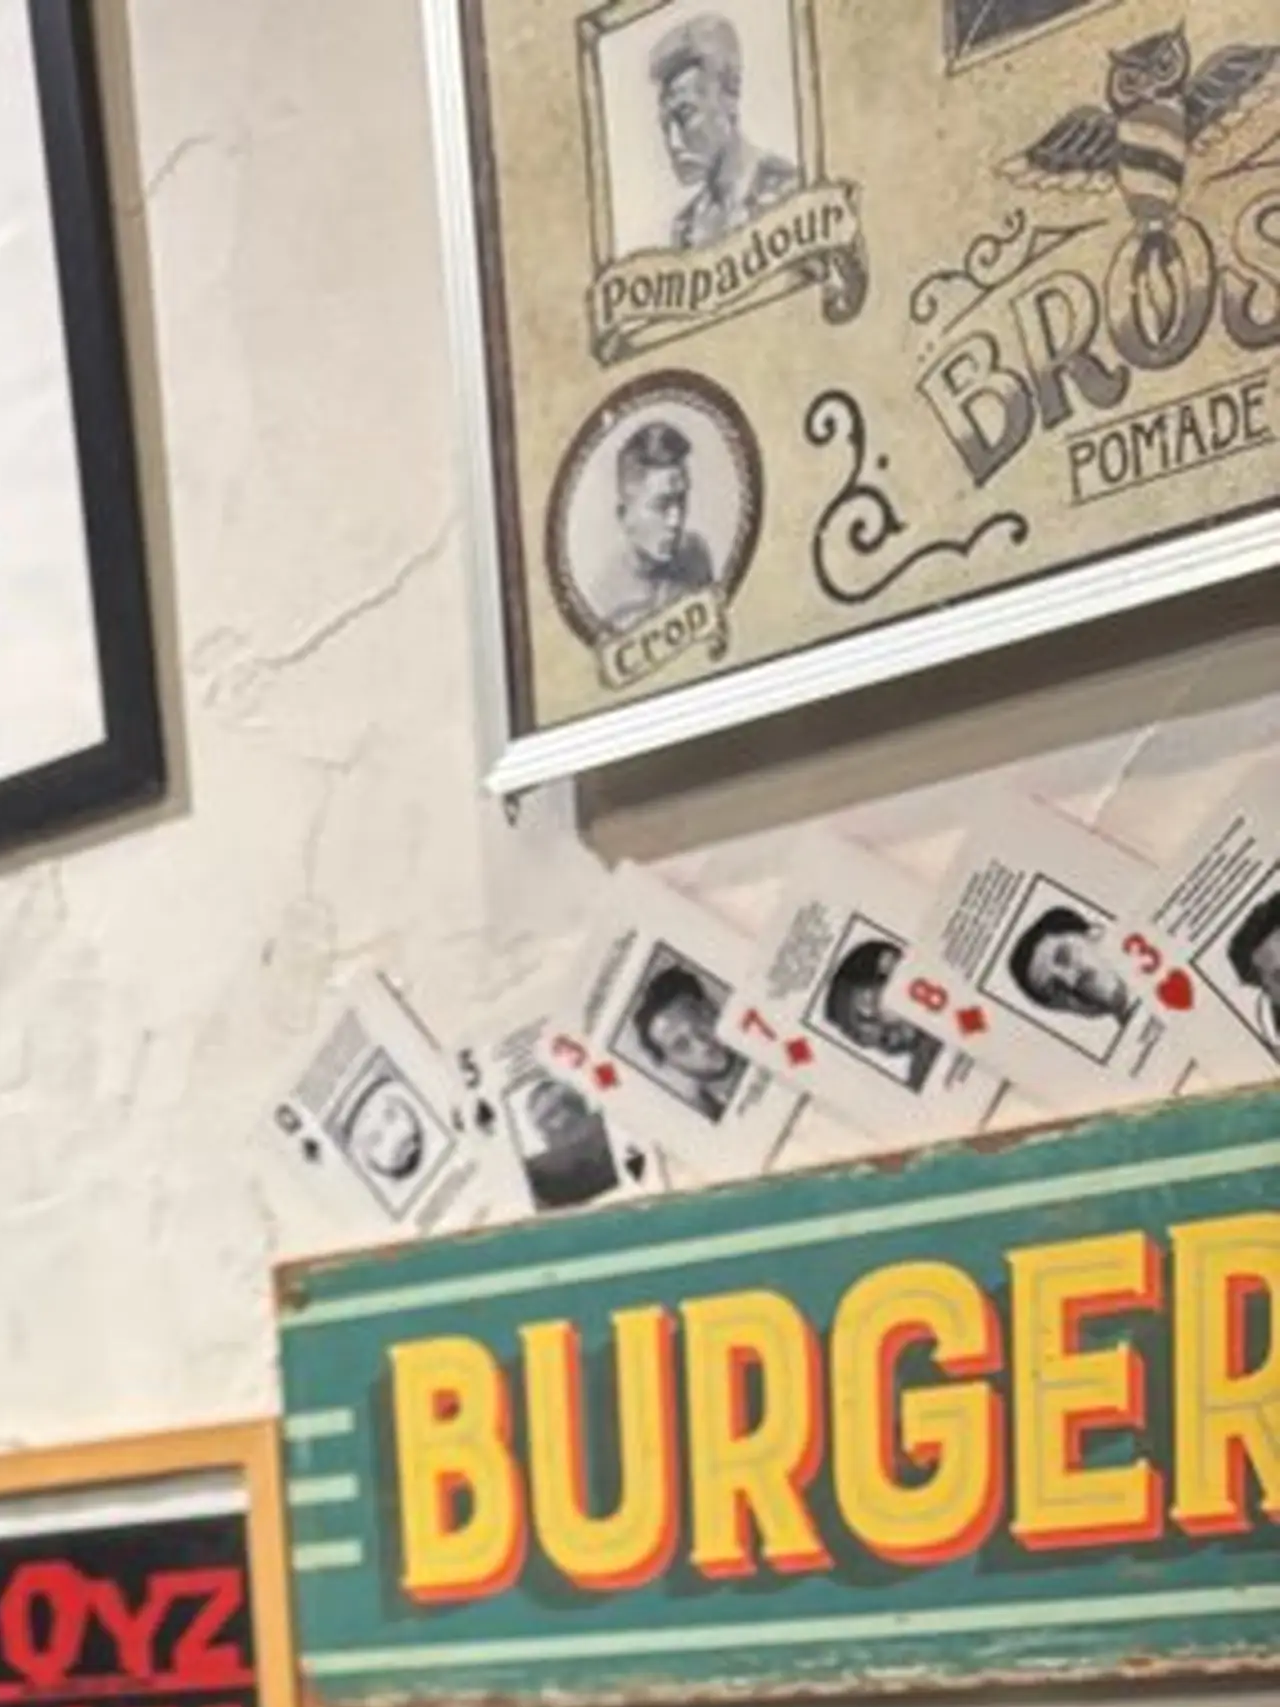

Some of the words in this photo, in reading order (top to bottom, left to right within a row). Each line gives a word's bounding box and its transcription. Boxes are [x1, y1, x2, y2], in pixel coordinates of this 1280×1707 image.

[1068, 380, 1270, 497] POMADE
[1121, 932, 1161, 975] 3
[908, 978, 949, 1012] 8
[741, 1008, 778, 1042] 7
[388, 1211, 1280, 1602] BURGER
